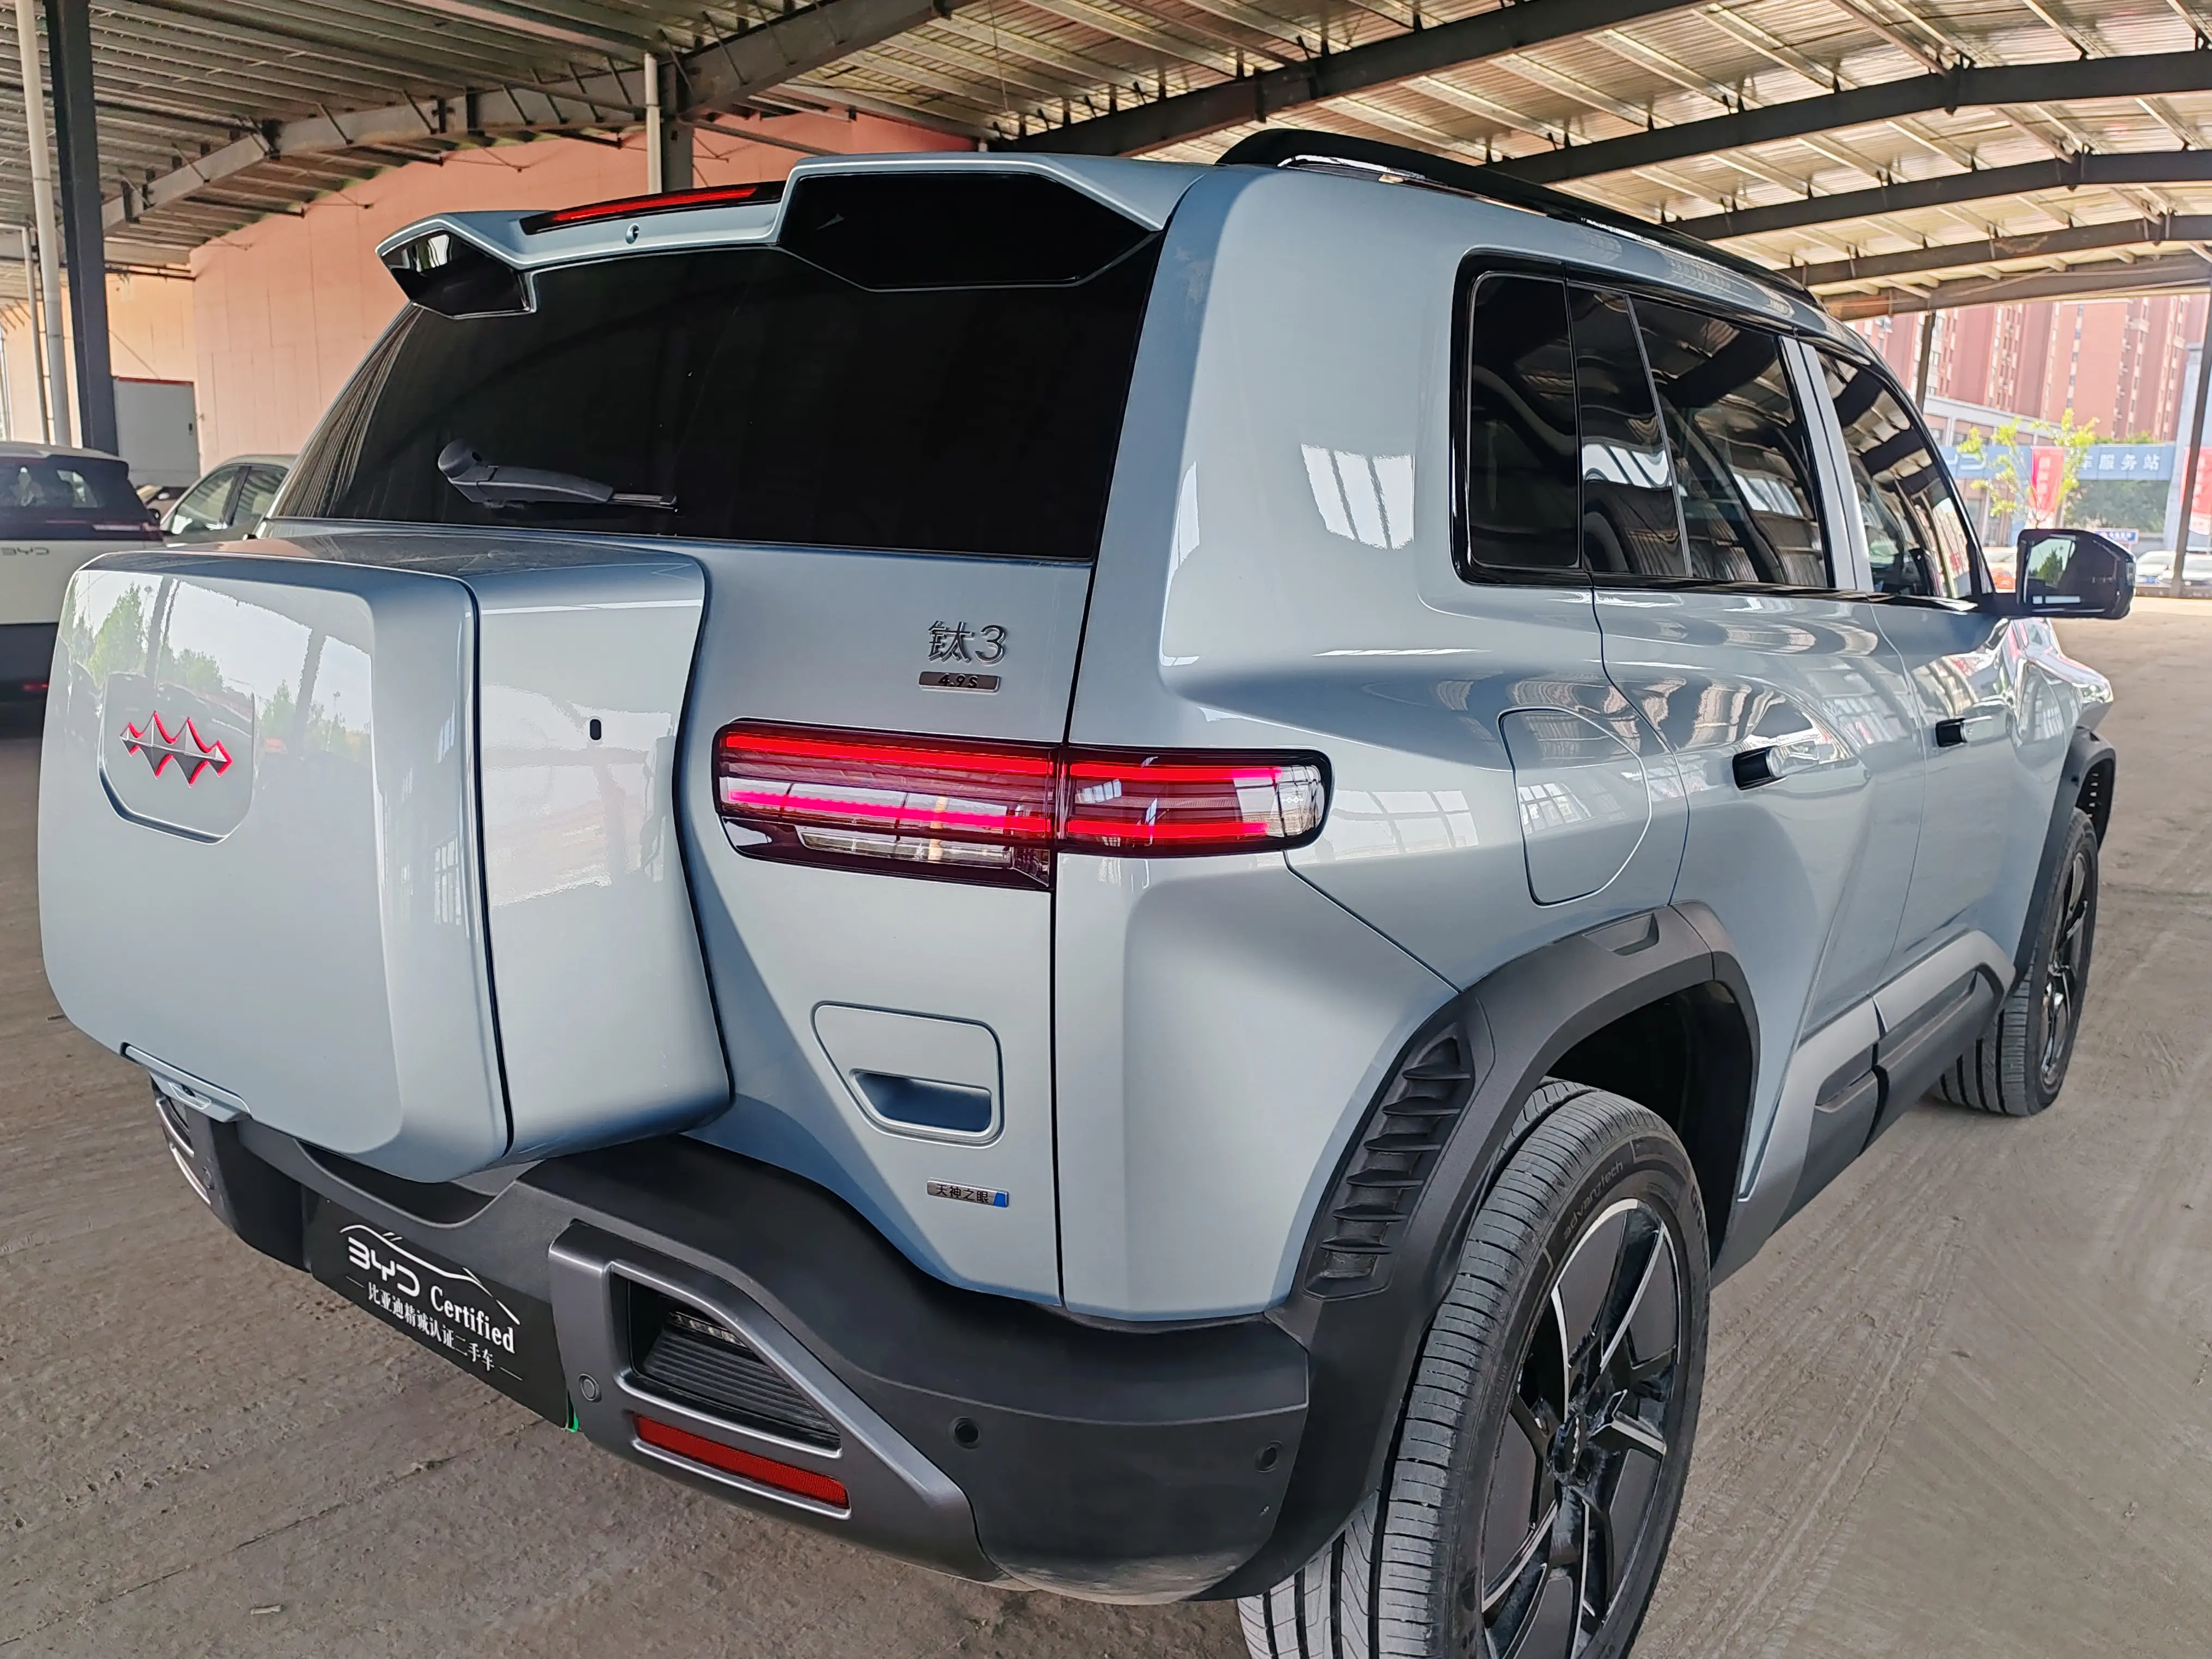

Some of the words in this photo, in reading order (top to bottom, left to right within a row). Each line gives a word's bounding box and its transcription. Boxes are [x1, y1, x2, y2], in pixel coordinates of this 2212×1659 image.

[928, 620, 1006, 664] 钛3
[938, 673, 978, 689] 4.9S
[936, 1183, 989, 1203] 天神之眼
[348, 1236, 420, 1297] BYD
[430, 1285, 515, 1354] Certified
[368, 1281, 495, 1371] 比亚迪精诚认证二手车
